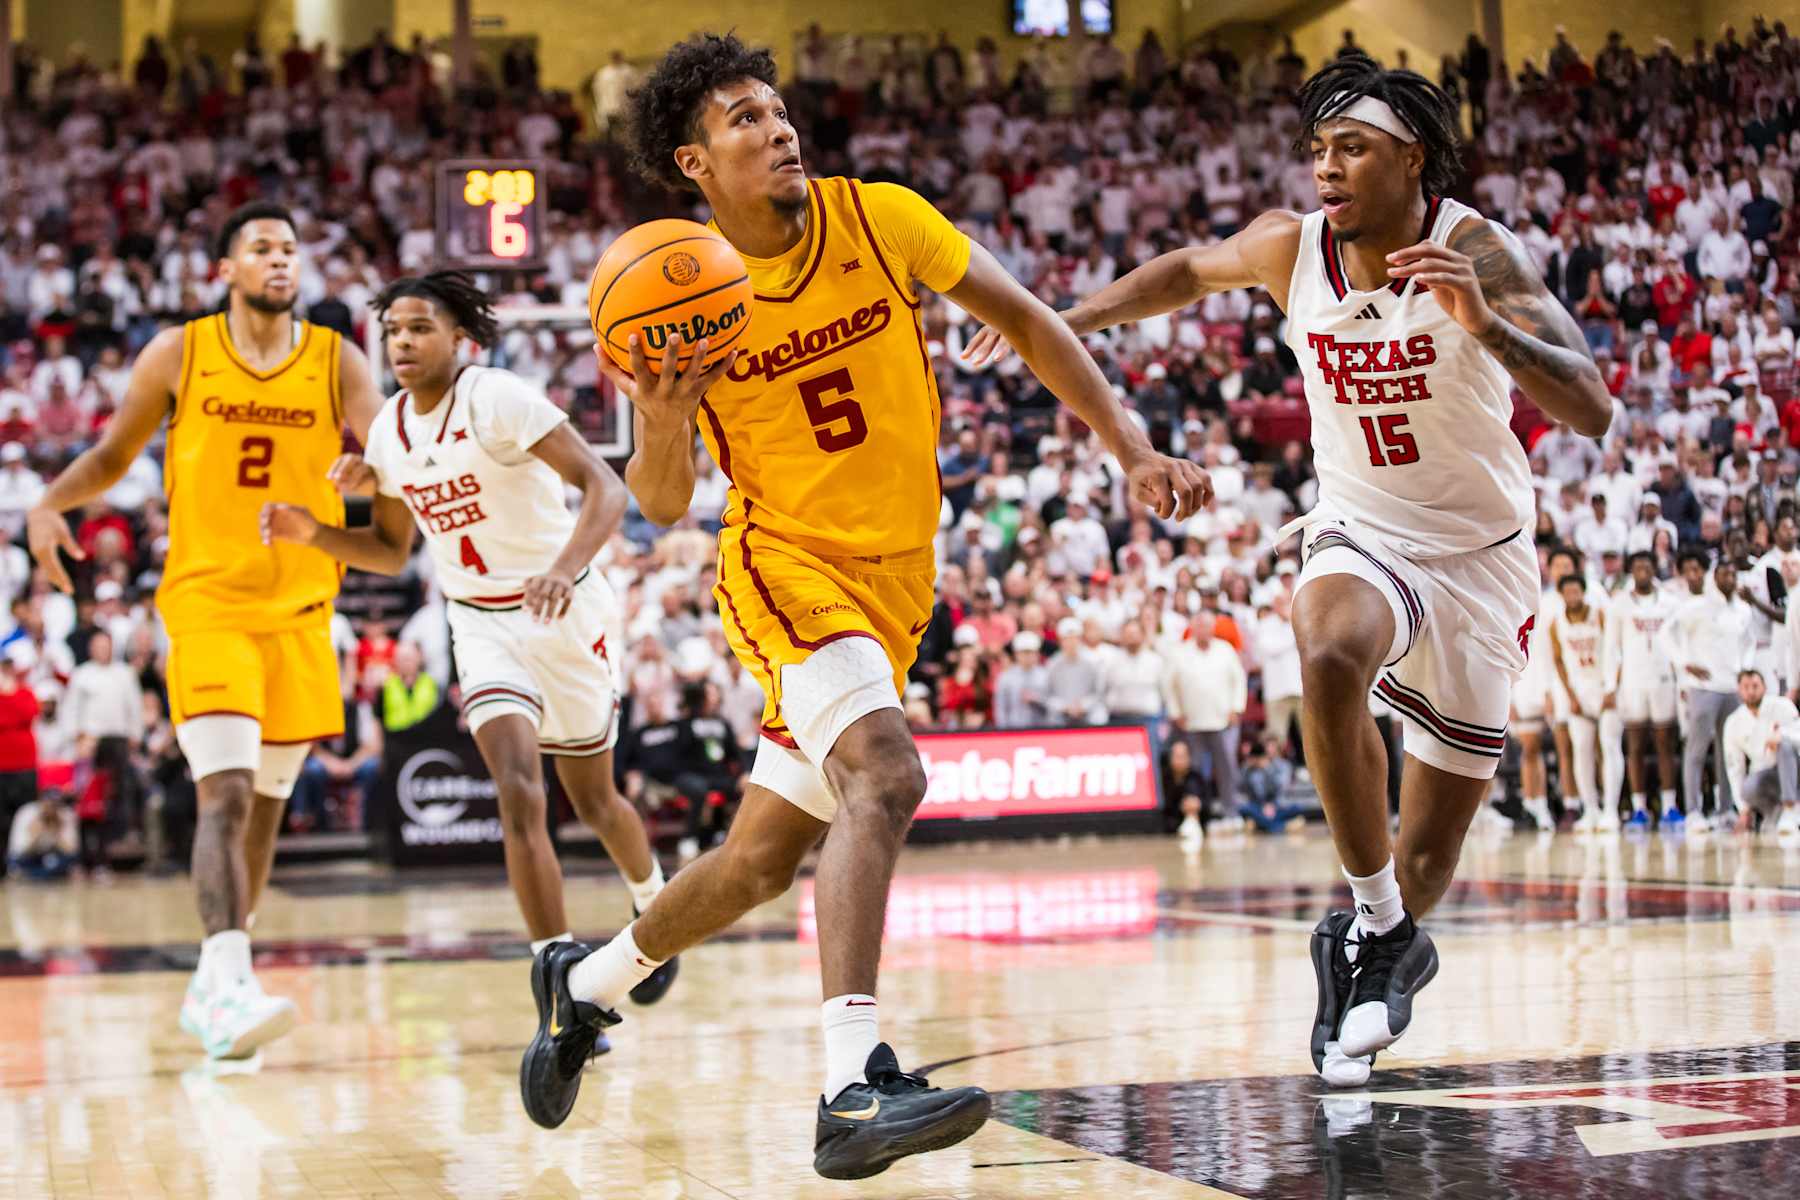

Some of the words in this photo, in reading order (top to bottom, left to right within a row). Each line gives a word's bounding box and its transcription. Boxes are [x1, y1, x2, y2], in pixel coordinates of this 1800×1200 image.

[490, 202, 528, 258] 6
[642, 302, 746, 349] Wilson
[726, 298, 891, 382] Cyclones
[1307, 332, 1437, 372] TEXAS
[1323, 369, 1432, 404] TECH
[202, 396, 316, 428] Cyclones
[797, 367, 868, 453] 5
[1358, 413, 1420, 466] 15
[237, 436, 274, 488] 2
[402, 474, 481, 515] TEXAS
[420, 502, 487, 534] TECH
[459, 535, 488, 575] 4
